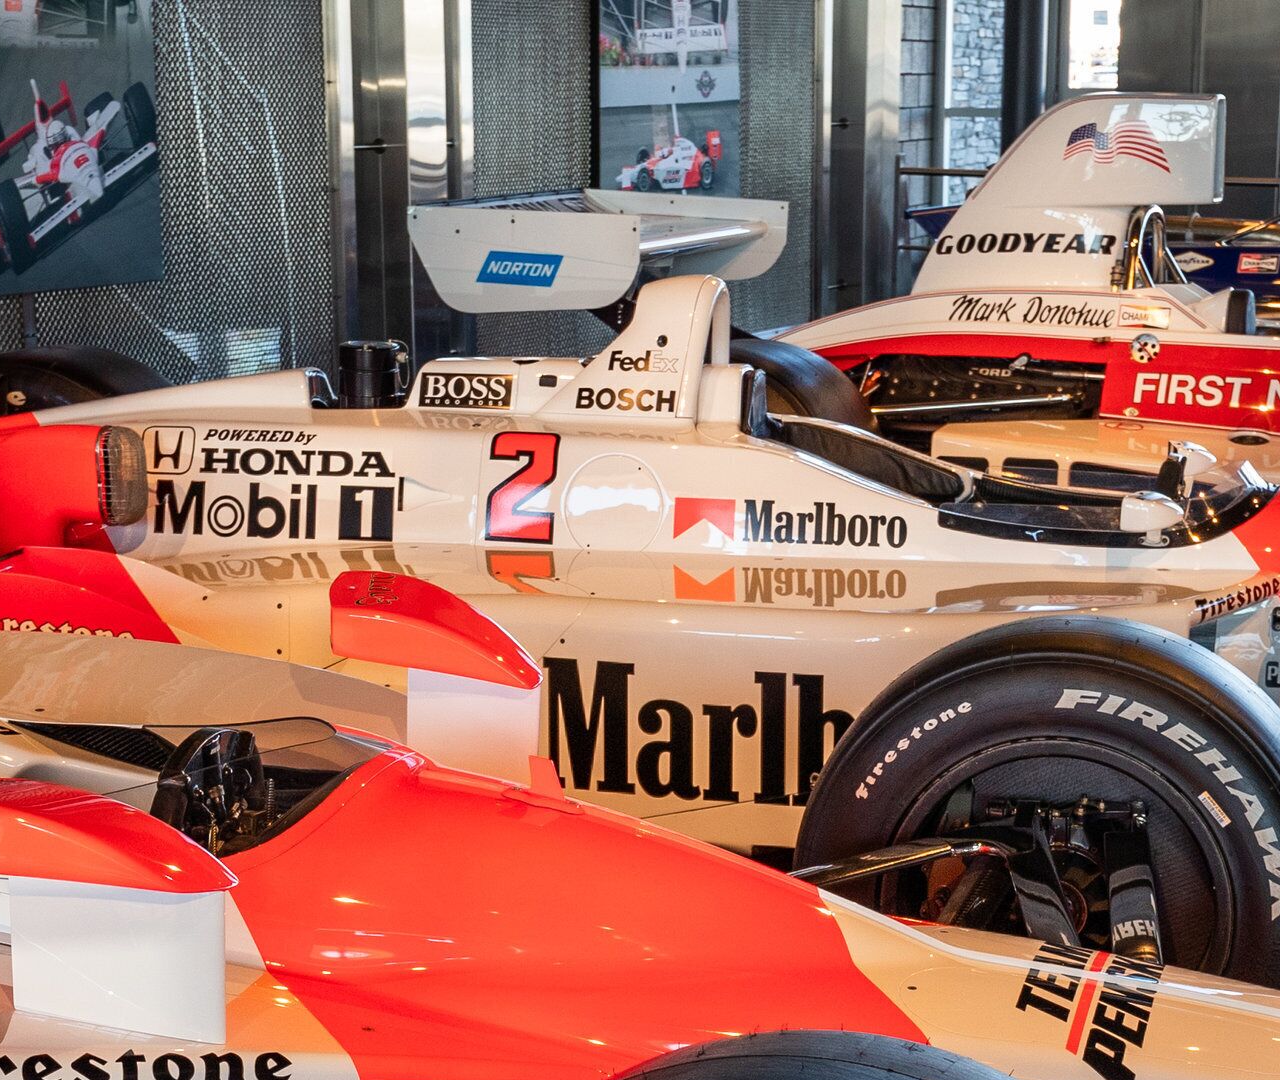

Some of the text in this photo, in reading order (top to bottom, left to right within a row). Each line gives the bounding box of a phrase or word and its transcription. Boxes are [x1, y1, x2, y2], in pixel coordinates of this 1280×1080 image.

[936, 233, 1116, 254] GOODYEAR
[486, 260, 555, 278] NORTON
[949, 294, 1115, 328] Mark Donohue
[608, 350, 679, 373] FedEx
[970, 367, 1012, 378] ORD
[424, 375, 508, 400] BOSS
[575, 387, 677, 413] BOSCH
[1132, 372, 1252, 407] FIRST
[425, 398, 504, 407] HUGO BOSS
[203, 429, 317, 446] POWERED by
[199, 448, 396, 478] HONDA
[484, 431, 561, 545] 2
[154, 479, 318, 539] Mobil
[742, 499, 908, 549] Marlboro
[1194, 577, 1280, 623] Firestone
[855, 700, 972, 800] Firestone
